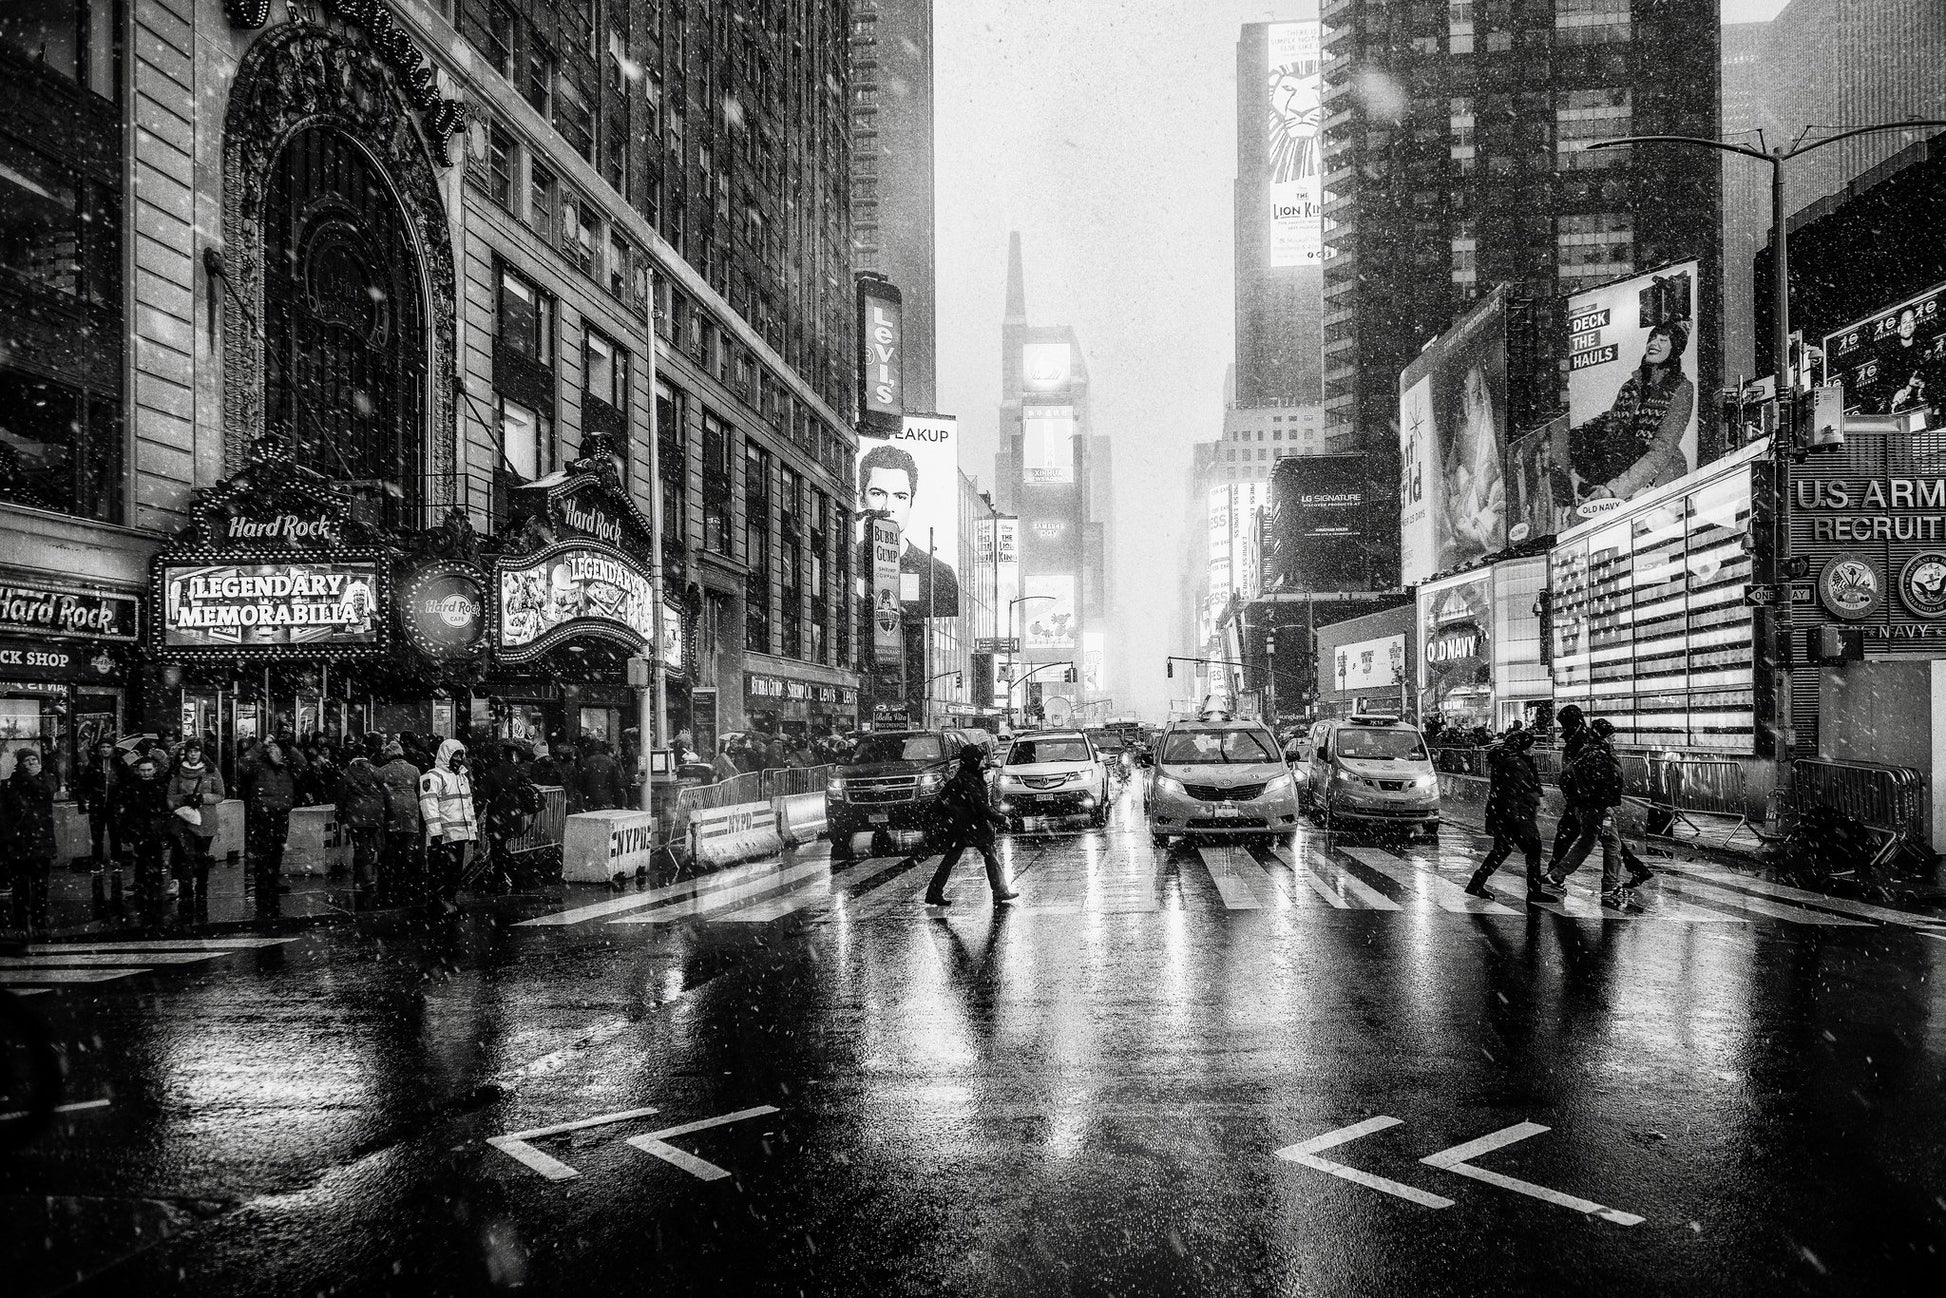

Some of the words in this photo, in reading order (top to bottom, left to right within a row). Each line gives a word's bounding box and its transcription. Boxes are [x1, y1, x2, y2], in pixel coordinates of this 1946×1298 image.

[1572, 312, 1606, 332] DECK
[1571, 333, 1597, 350] THE
[873, 306, 895, 404] Levi's
[1572, 347, 1613, 369] HAULS
[1301, 495, 1312, 503] LG
[1313, 493, 1362, 502] SIGNATURE
[1582, 504, 1598, 514] OLD
[1599, 501, 1621, 512] NAVY
[228, 515, 283, 538] Hard
[283, 514, 331, 541] Rock
[566, 499, 596, 532] Hard
[595, 510, 622, 548] Rock
[874, 525, 900, 546] BUBBA
[876, 545, 898, 563] GUMP
[571, 557, 638, 593] LEGENDARY
[875, 572, 899, 581] COMPANY
[194, 575, 344, 598] LEGENDARY
[1791, 590, 1806, 600] AY
[58, 596, 114, 633] Rock
[178, 603, 359, 627] MEMORABILIA
[425, 600, 458, 614] Hard
[458, 600, 481, 618] Rock
[1878, 624, 1929, 639] NAVY
[0, 650, 23, 665] CK
[26, 652, 69, 667] SHOP
[1447, 636, 1476, 660] NAVY
[728, 812, 752, 834] NYPD
[616, 826, 647, 856] NYPD
